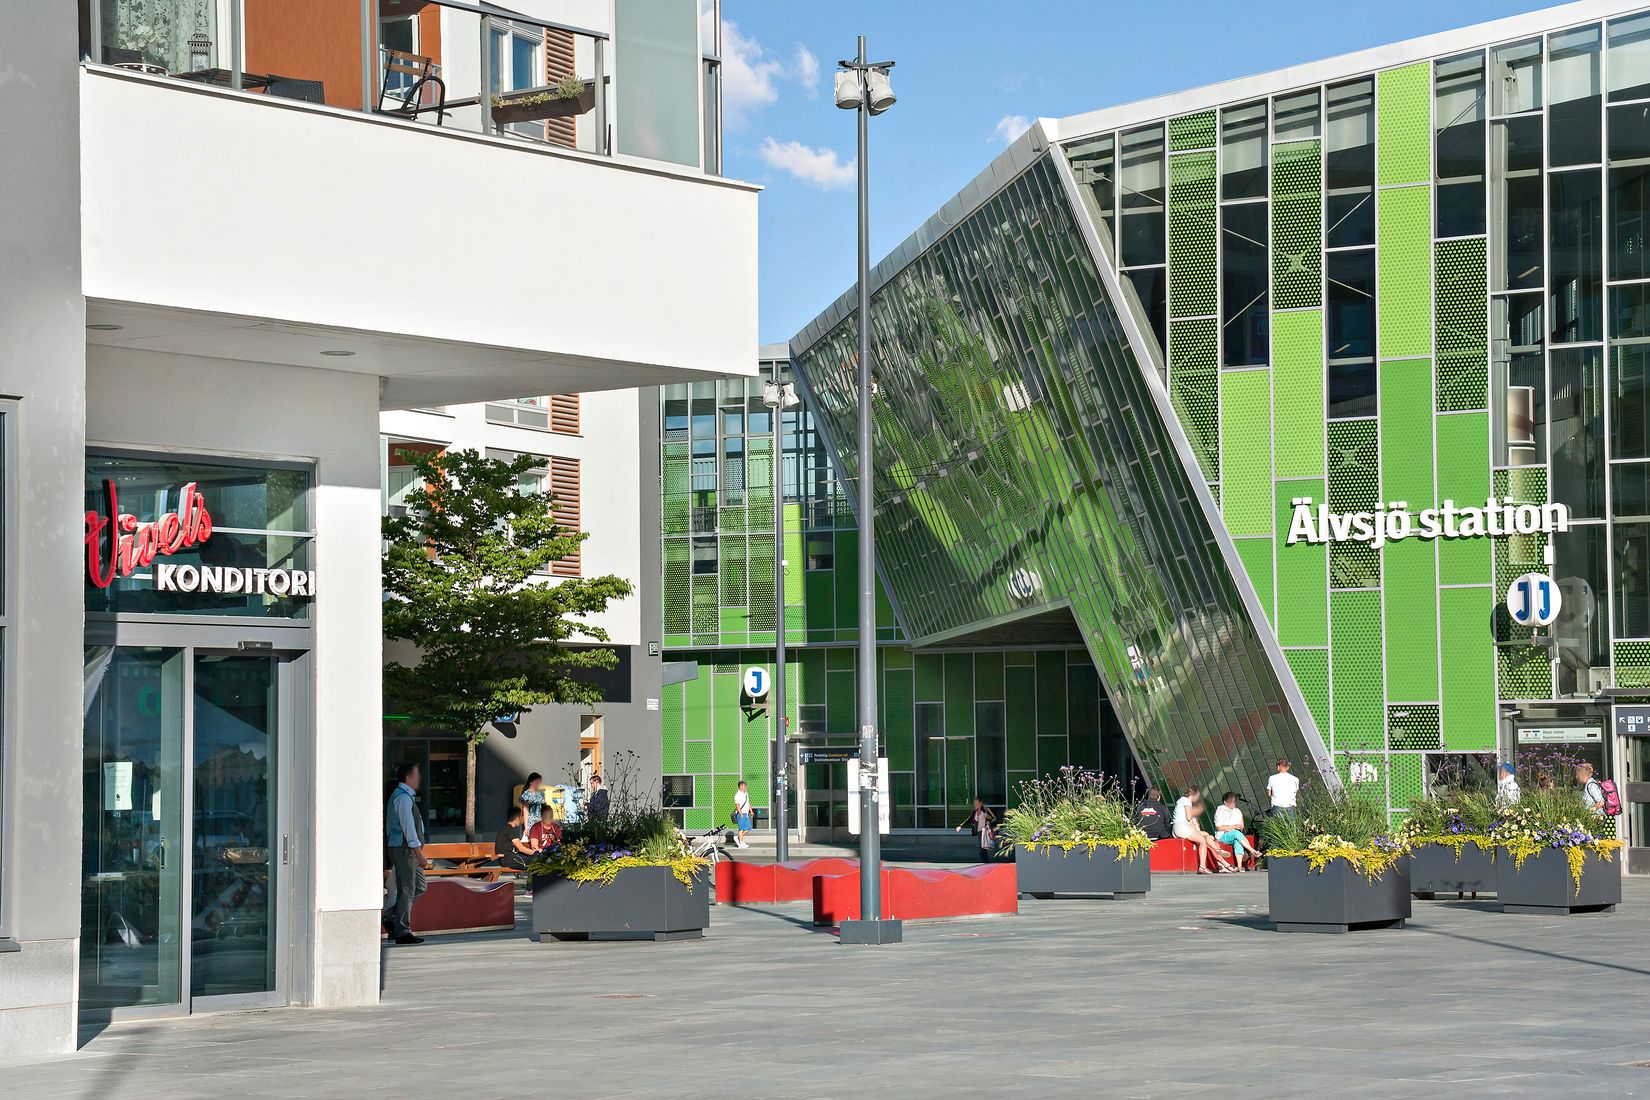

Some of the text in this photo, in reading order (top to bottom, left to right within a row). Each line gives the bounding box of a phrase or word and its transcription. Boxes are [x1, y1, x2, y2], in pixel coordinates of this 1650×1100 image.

[1287, 497, 1568, 549] Älvsjö station
[157, 563, 316, 596] KONDITORI
[750, 671, 762, 693] J
